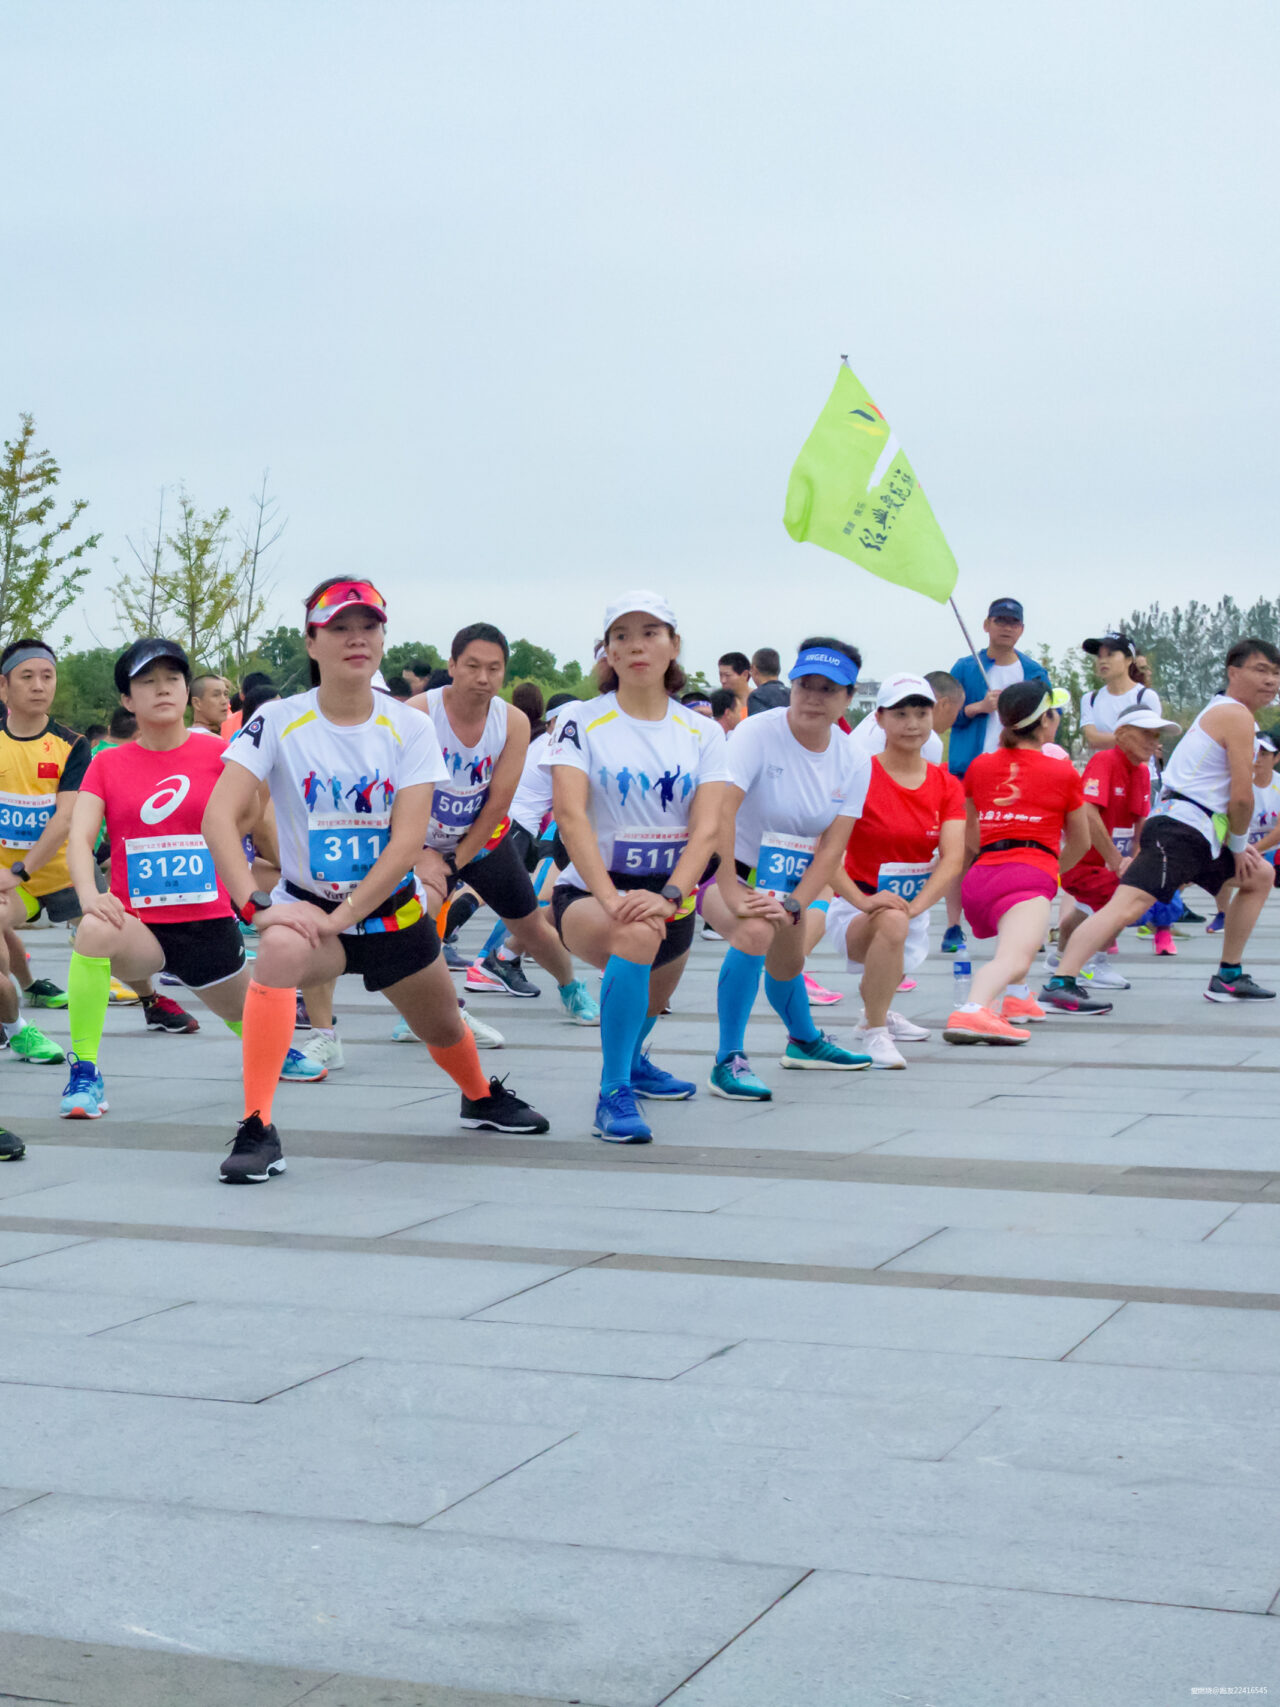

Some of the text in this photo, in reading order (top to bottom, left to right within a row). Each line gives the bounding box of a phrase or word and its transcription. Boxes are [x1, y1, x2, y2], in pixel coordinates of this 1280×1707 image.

[438, 795, 483, 816] 5042
[0, 808, 51, 829] 3049
[138, 854, 204, 880] 3120
[625, 846, 687, 869] 511
